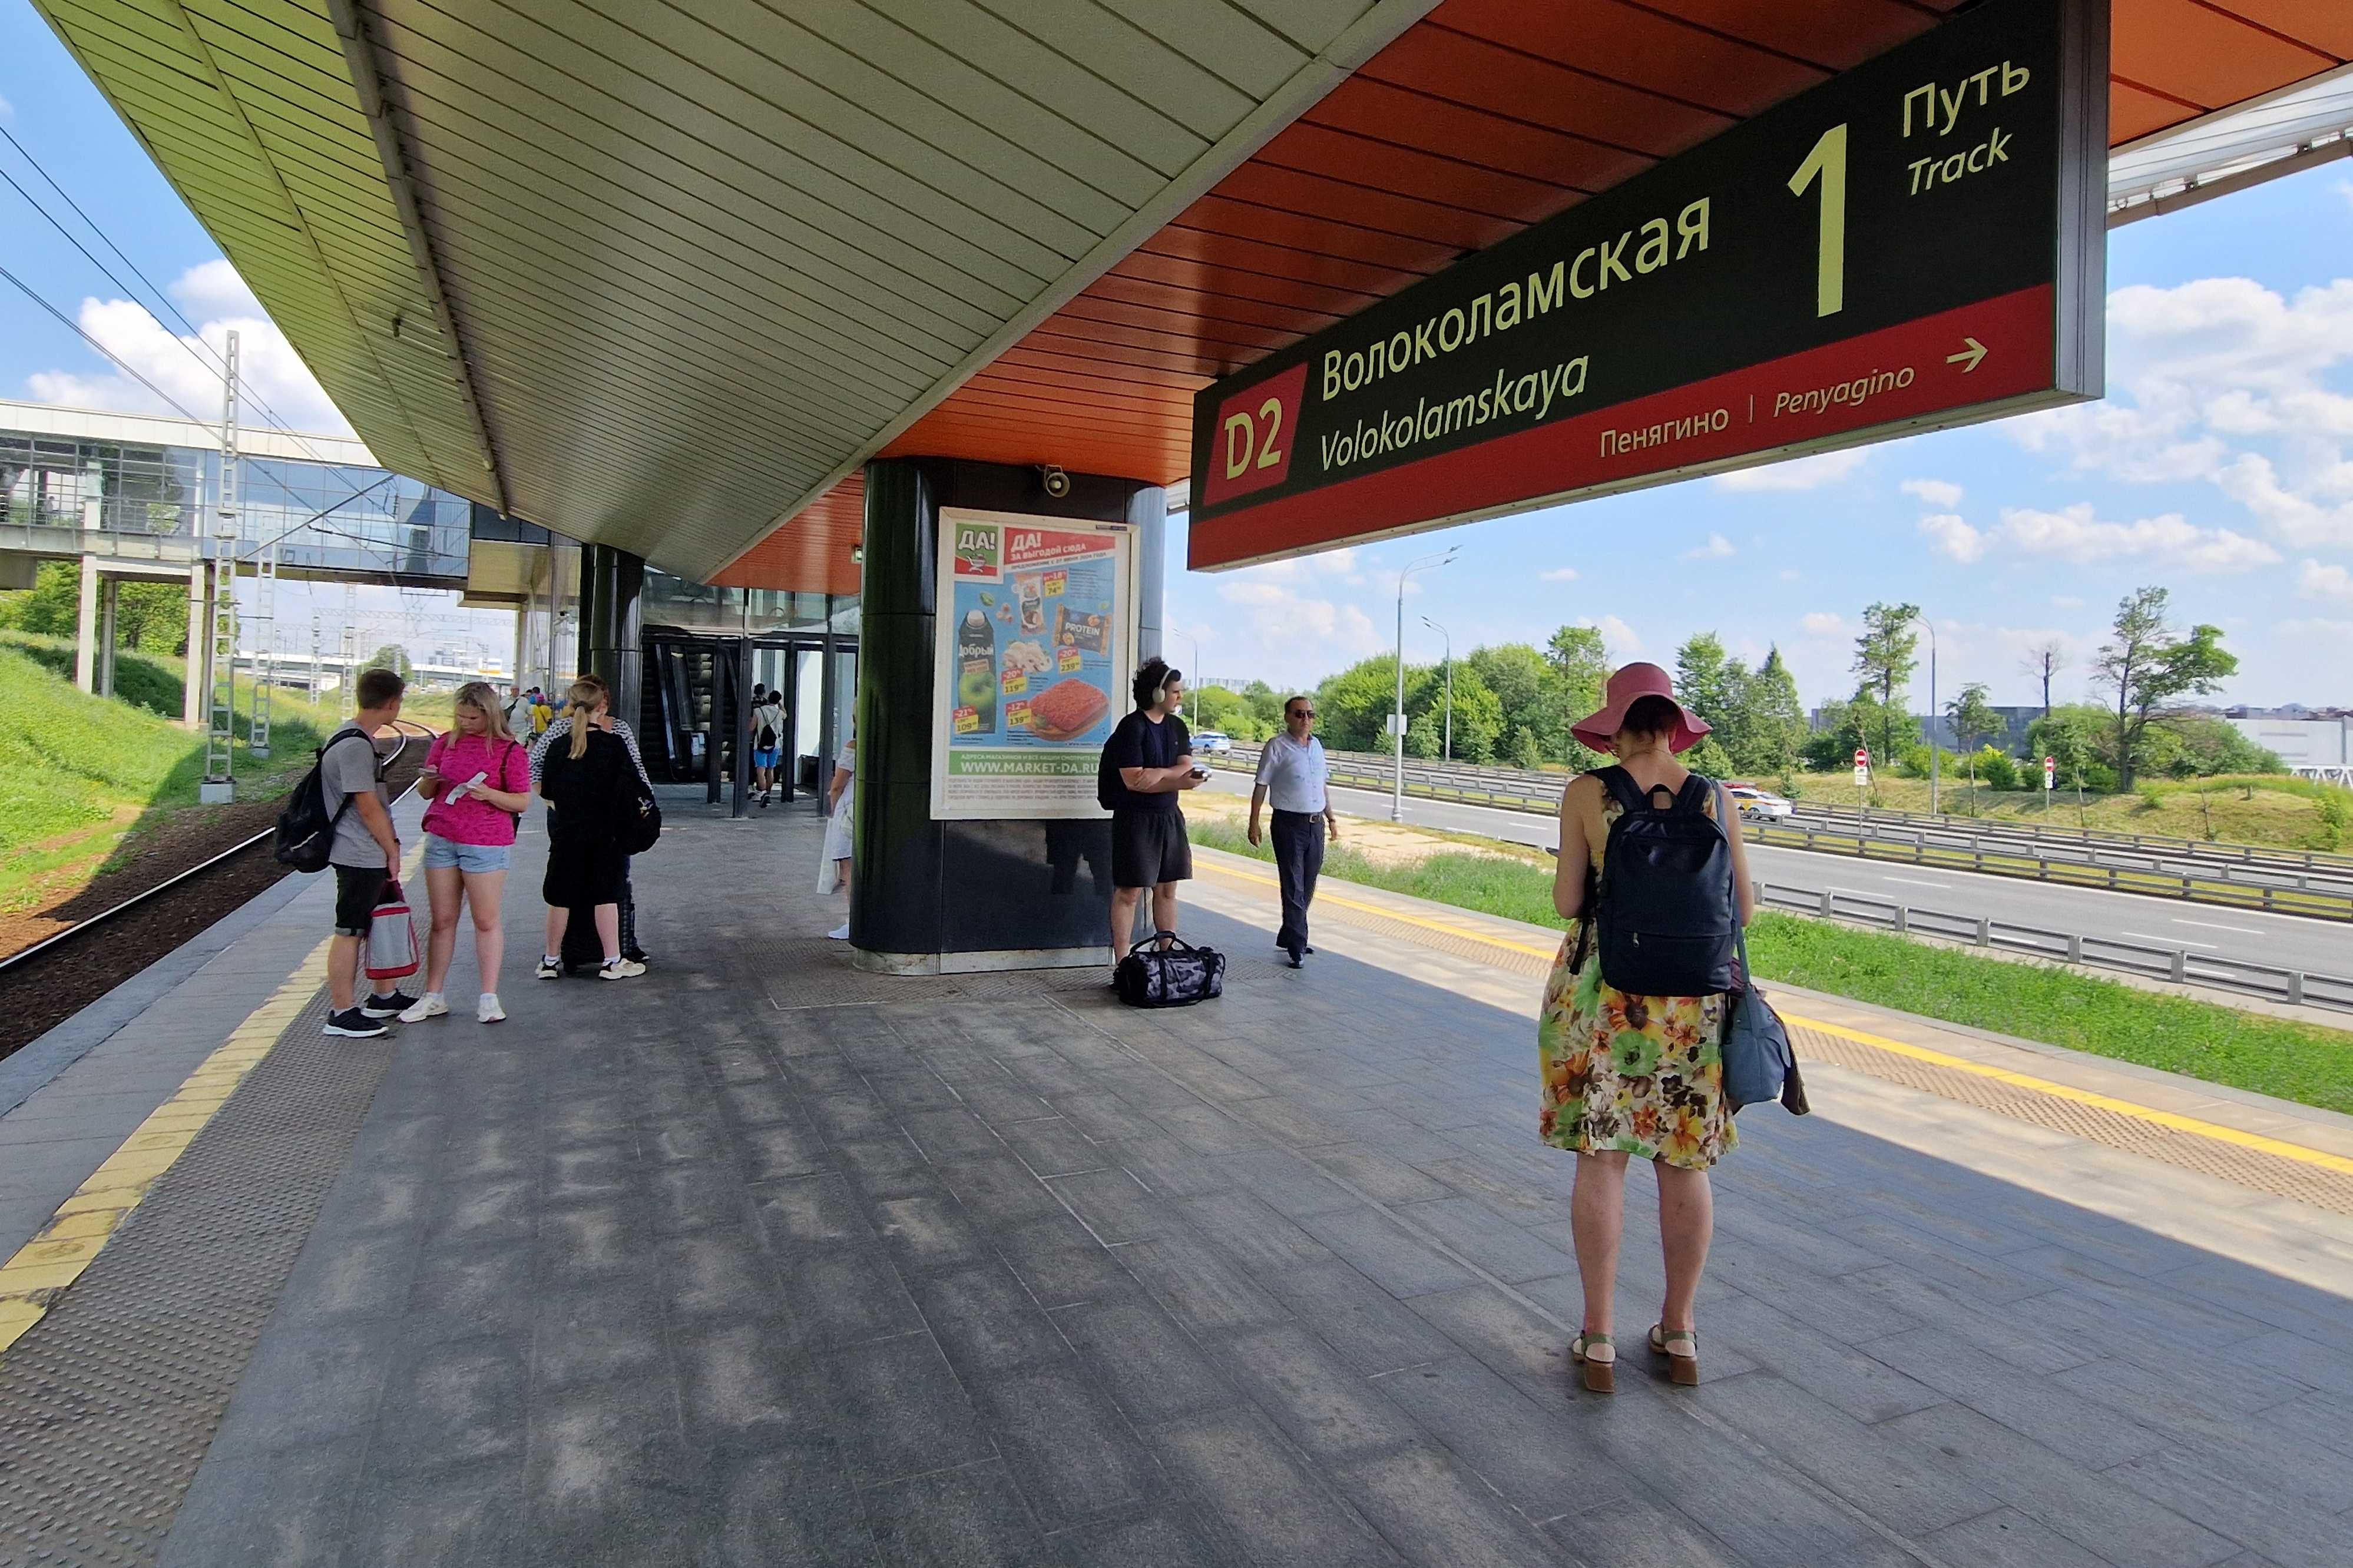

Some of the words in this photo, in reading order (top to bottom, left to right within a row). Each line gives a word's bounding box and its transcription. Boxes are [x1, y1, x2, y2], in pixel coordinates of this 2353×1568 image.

[1903, 61, 2030, 137] Путь
[1907, 126, 2012, 195] Track
[1787, 122, 1847, 317] 1
[1321, 197, 1710, 402] Волоколамская
[1321, 354, 1589, 471] Volokolamskaya
[1773, 363, 1915, 417] Penyagino
[1224, 397, 1282, 479] D2
[1599, 408, 1729, 459] Пенягино
[958, 531, 995, 551] ДА!
[1011, 532, 1042, 552] ДА!
[1011, 552, 1021, 561] ЗА
[1063, 543, 1087, 554] СЮДА
[1065, 622, 1101, 637] PROTEIN
[960, 761, 1098, 774] WWW.MARKET-DA.RU
